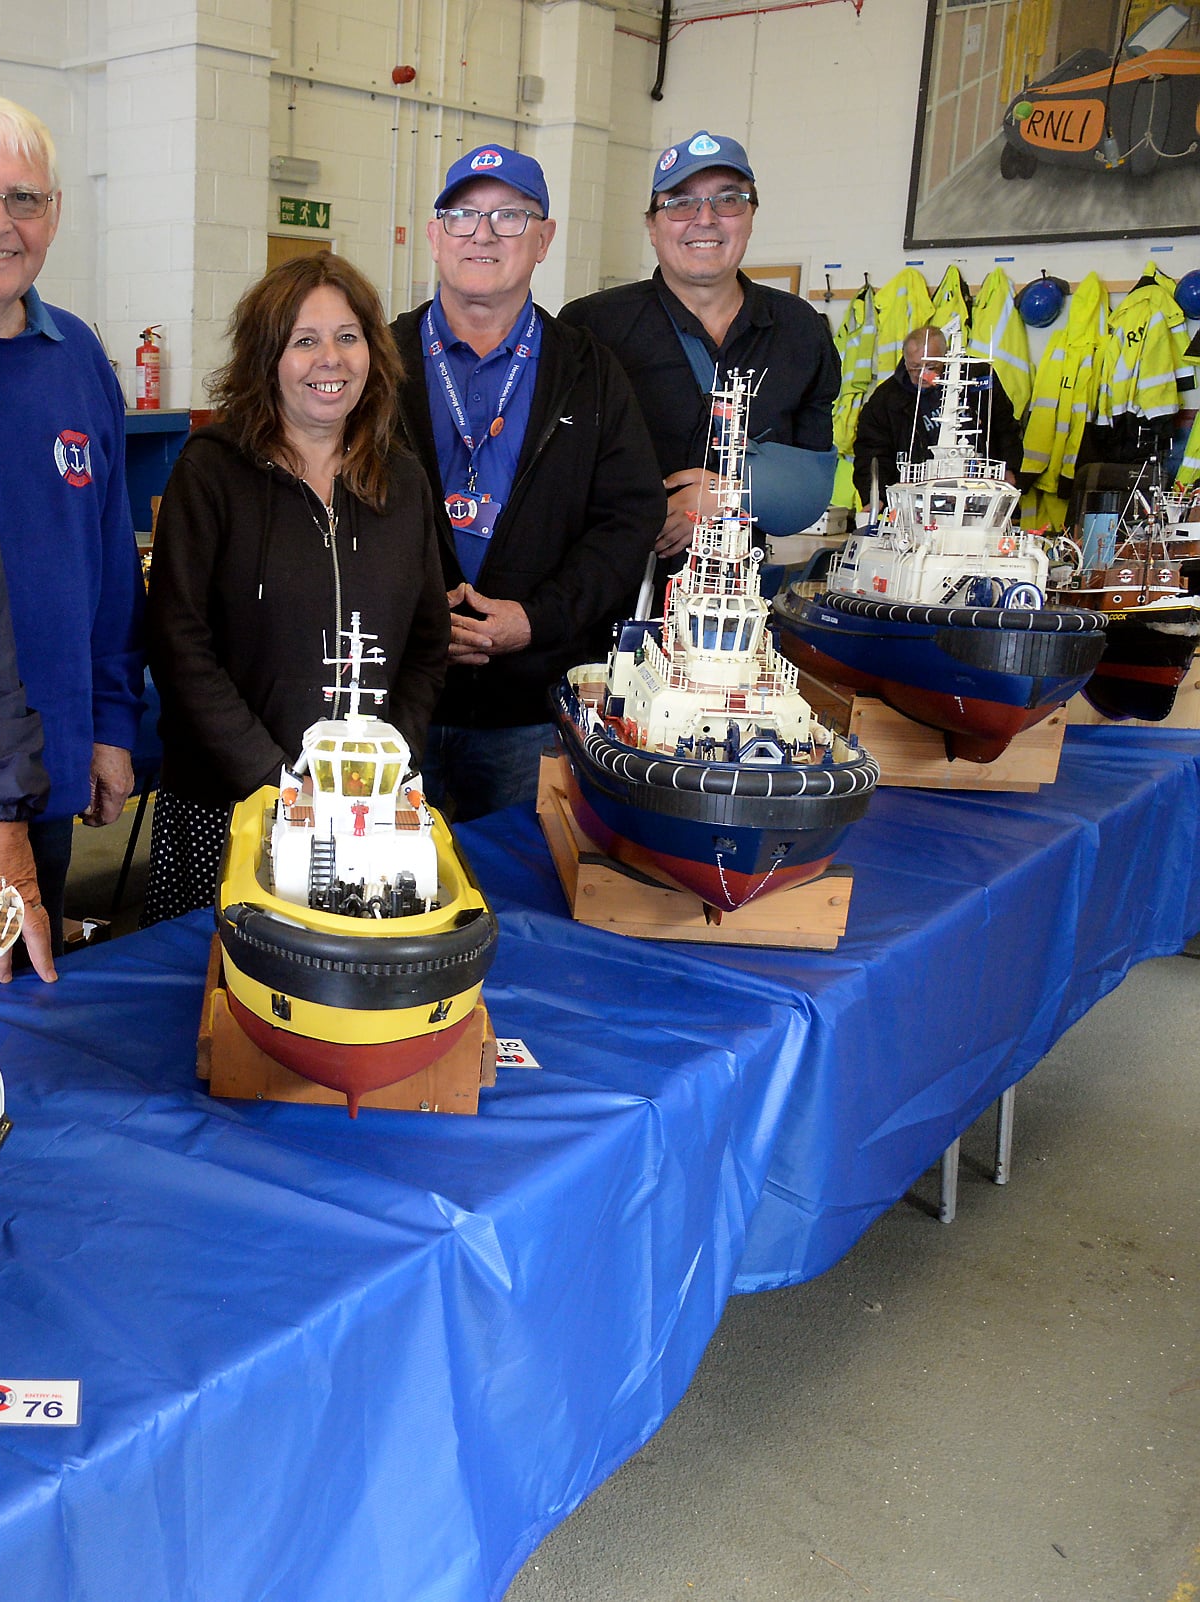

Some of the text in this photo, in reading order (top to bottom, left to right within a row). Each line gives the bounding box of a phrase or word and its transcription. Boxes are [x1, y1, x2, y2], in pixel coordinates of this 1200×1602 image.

[1027, 110, 1091, 144] RNLI
[282, 201, 296, 211] FIRE
[282, 213, 295, 221] EXIT
[439, 361, 466, 426] Heron Model Boat Club
[22, 1400, 63, 1418] 76
